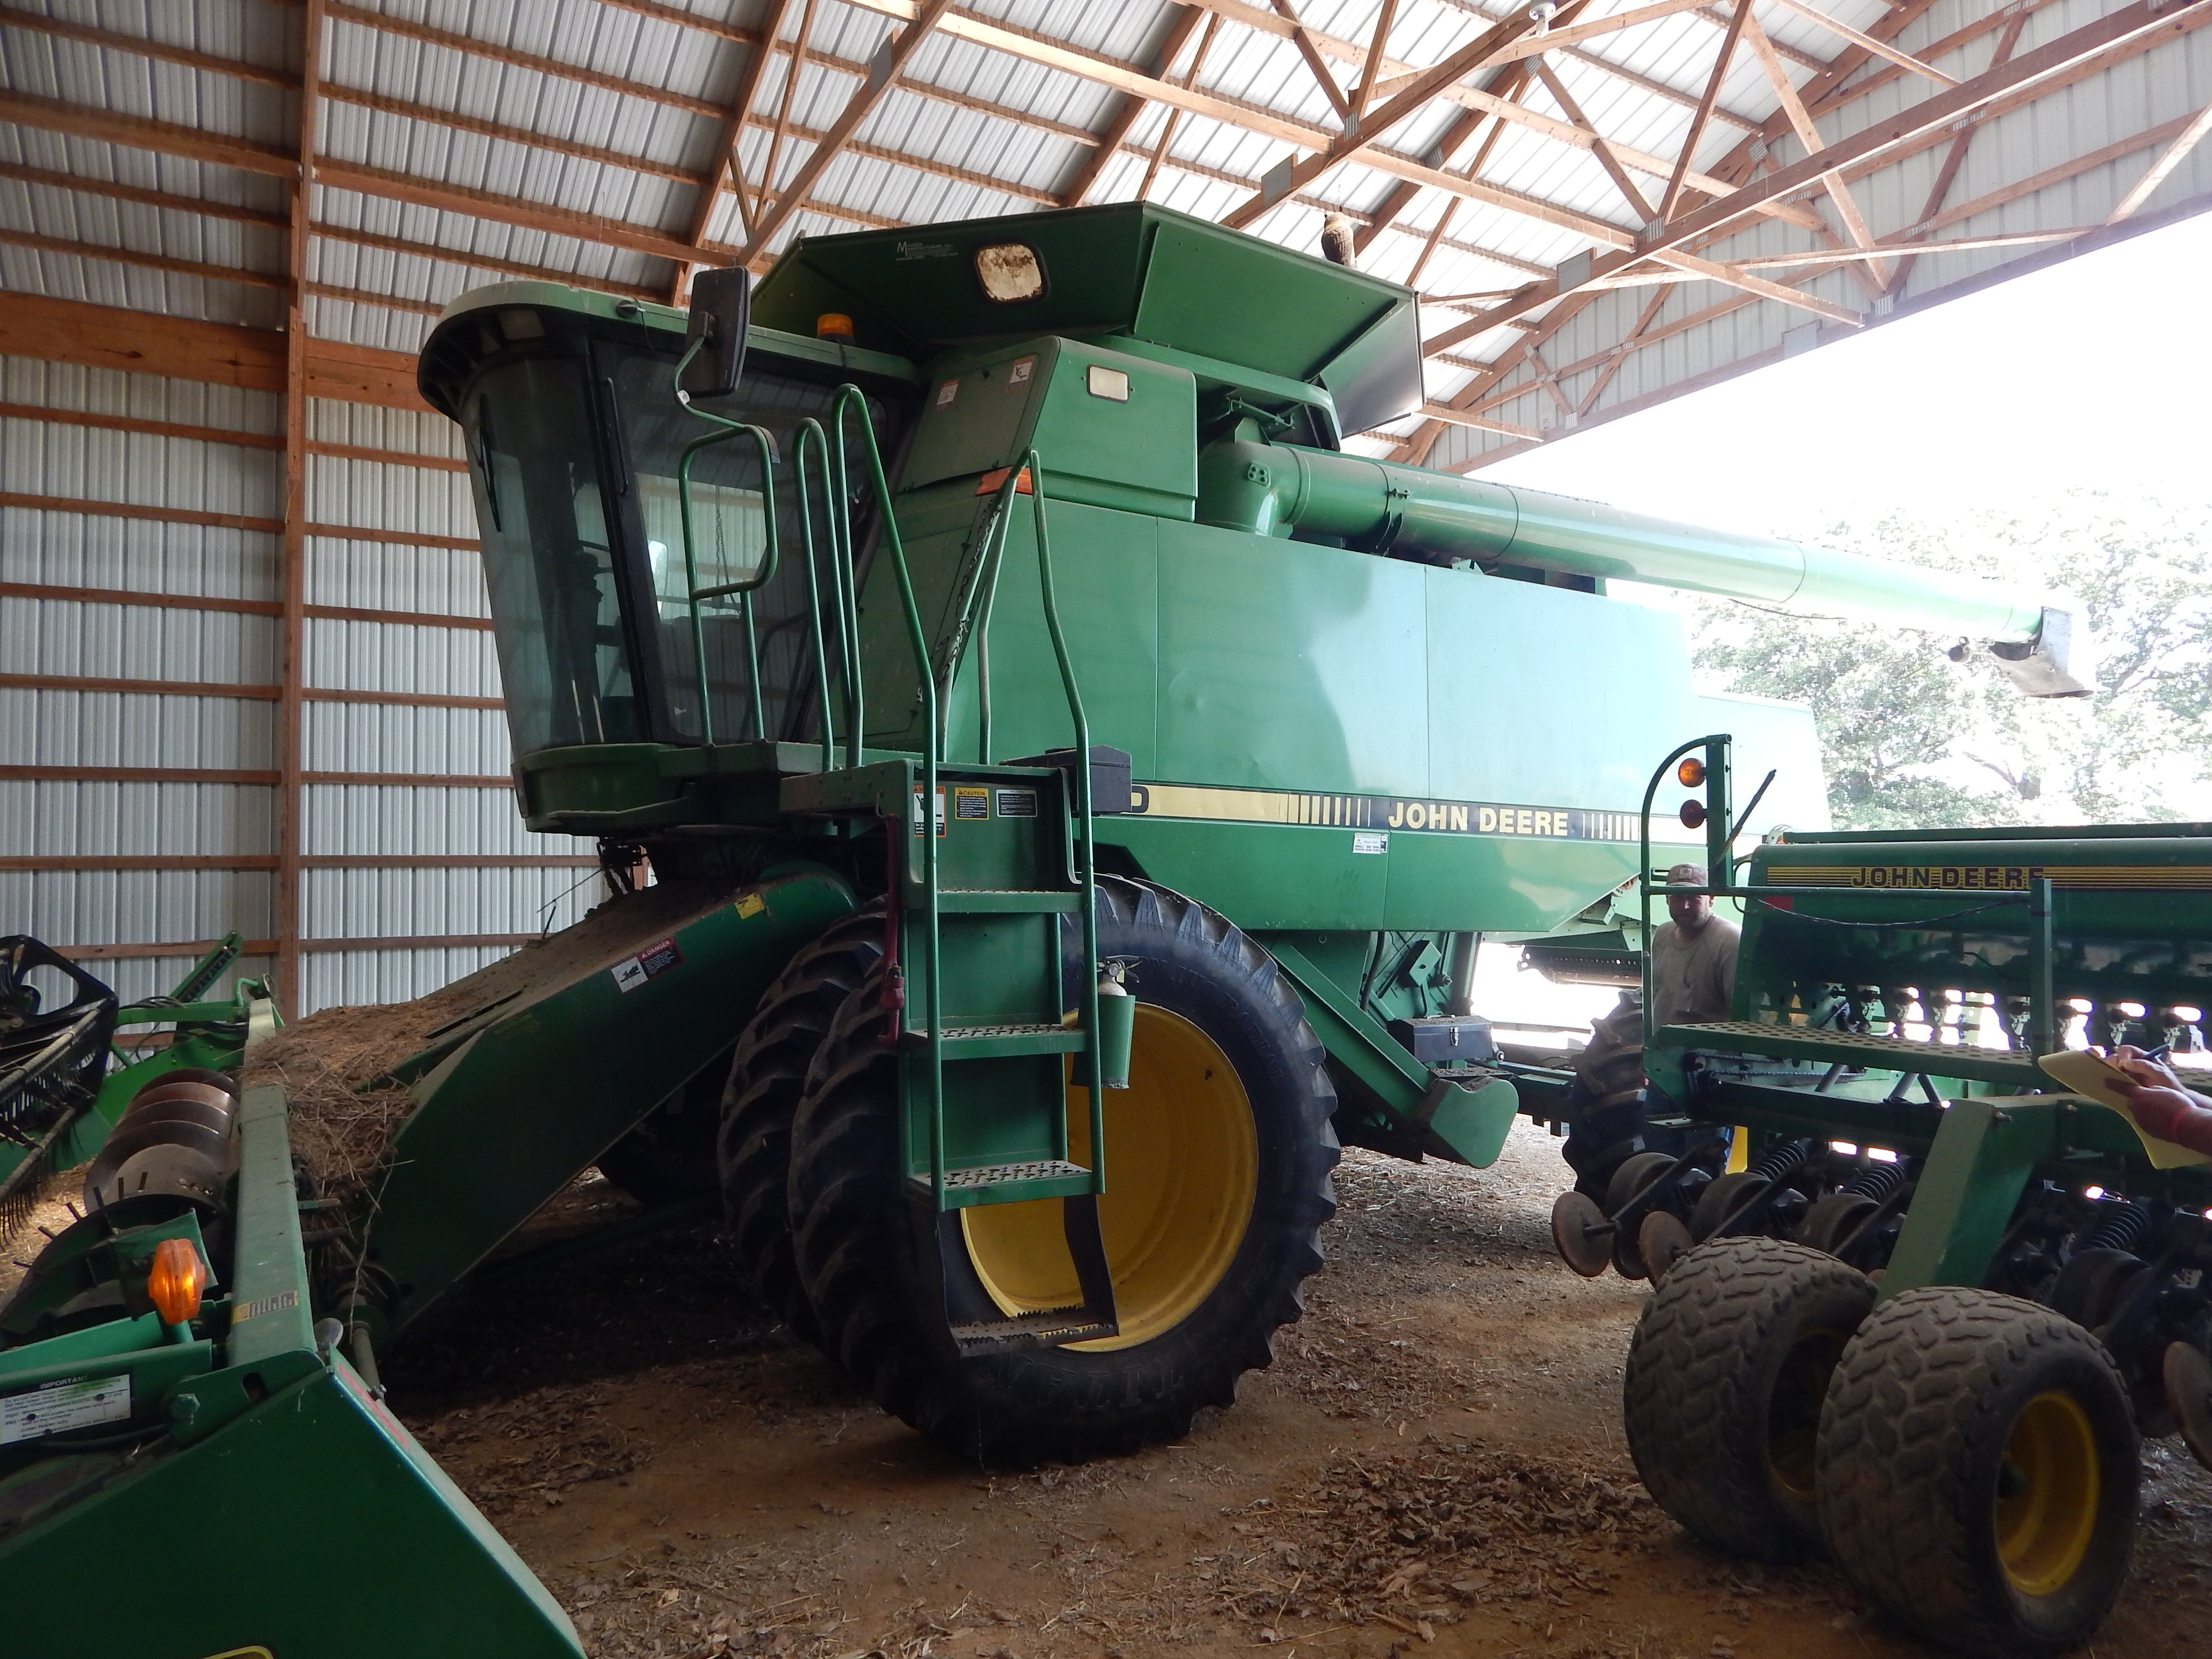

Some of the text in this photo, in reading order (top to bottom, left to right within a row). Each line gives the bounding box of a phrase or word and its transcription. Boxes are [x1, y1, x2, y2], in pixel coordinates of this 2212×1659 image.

[1388, 802, 1568, 836] JOHN DEERE
[1852, 867, 1929, 886] JOHN
[647, 940, 671, 955] DANGER
[1218, 993, 1283, 1080] RADIAL
[40, 1375, 88, 1389] IMPORTANT
